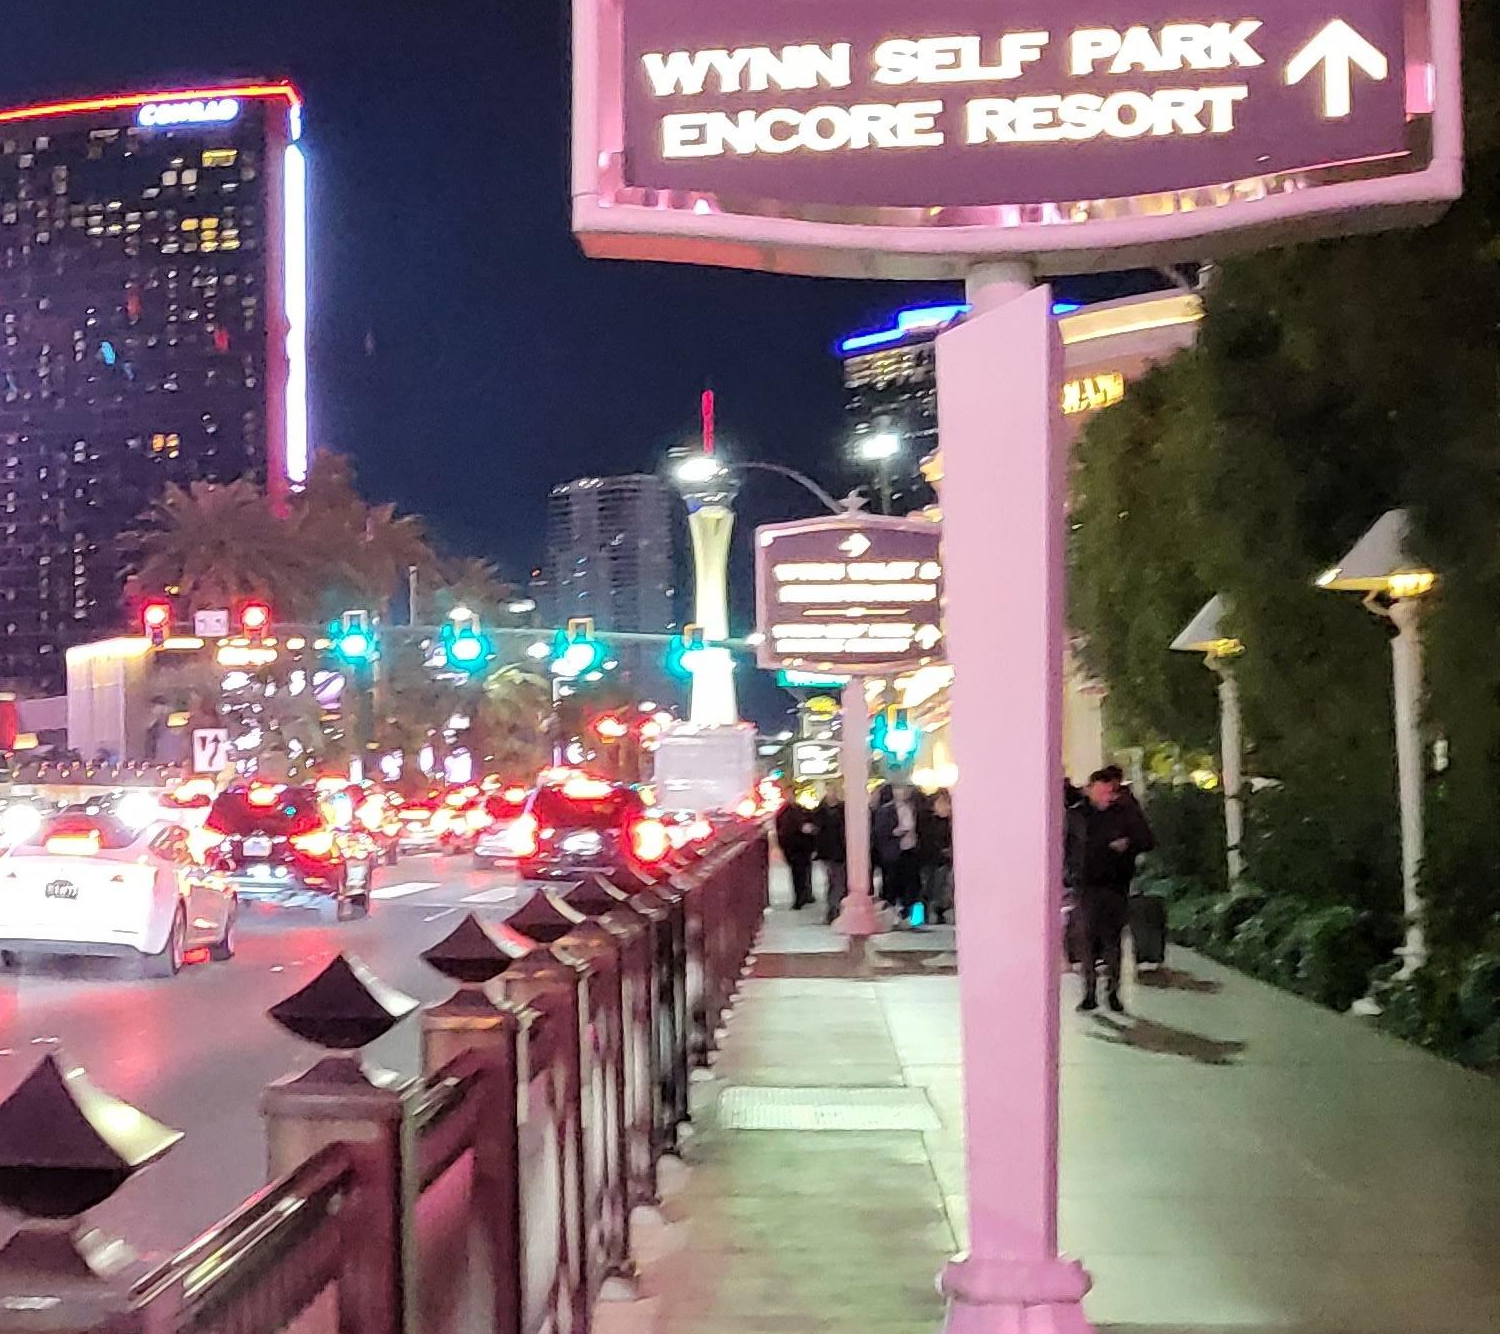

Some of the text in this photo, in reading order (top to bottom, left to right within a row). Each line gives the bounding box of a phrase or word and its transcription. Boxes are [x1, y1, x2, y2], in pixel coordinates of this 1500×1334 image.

[641, 19, 1266, 97] WYNN SELF PARK
[661, 85, 1249, 158] ENCORE RESORT
